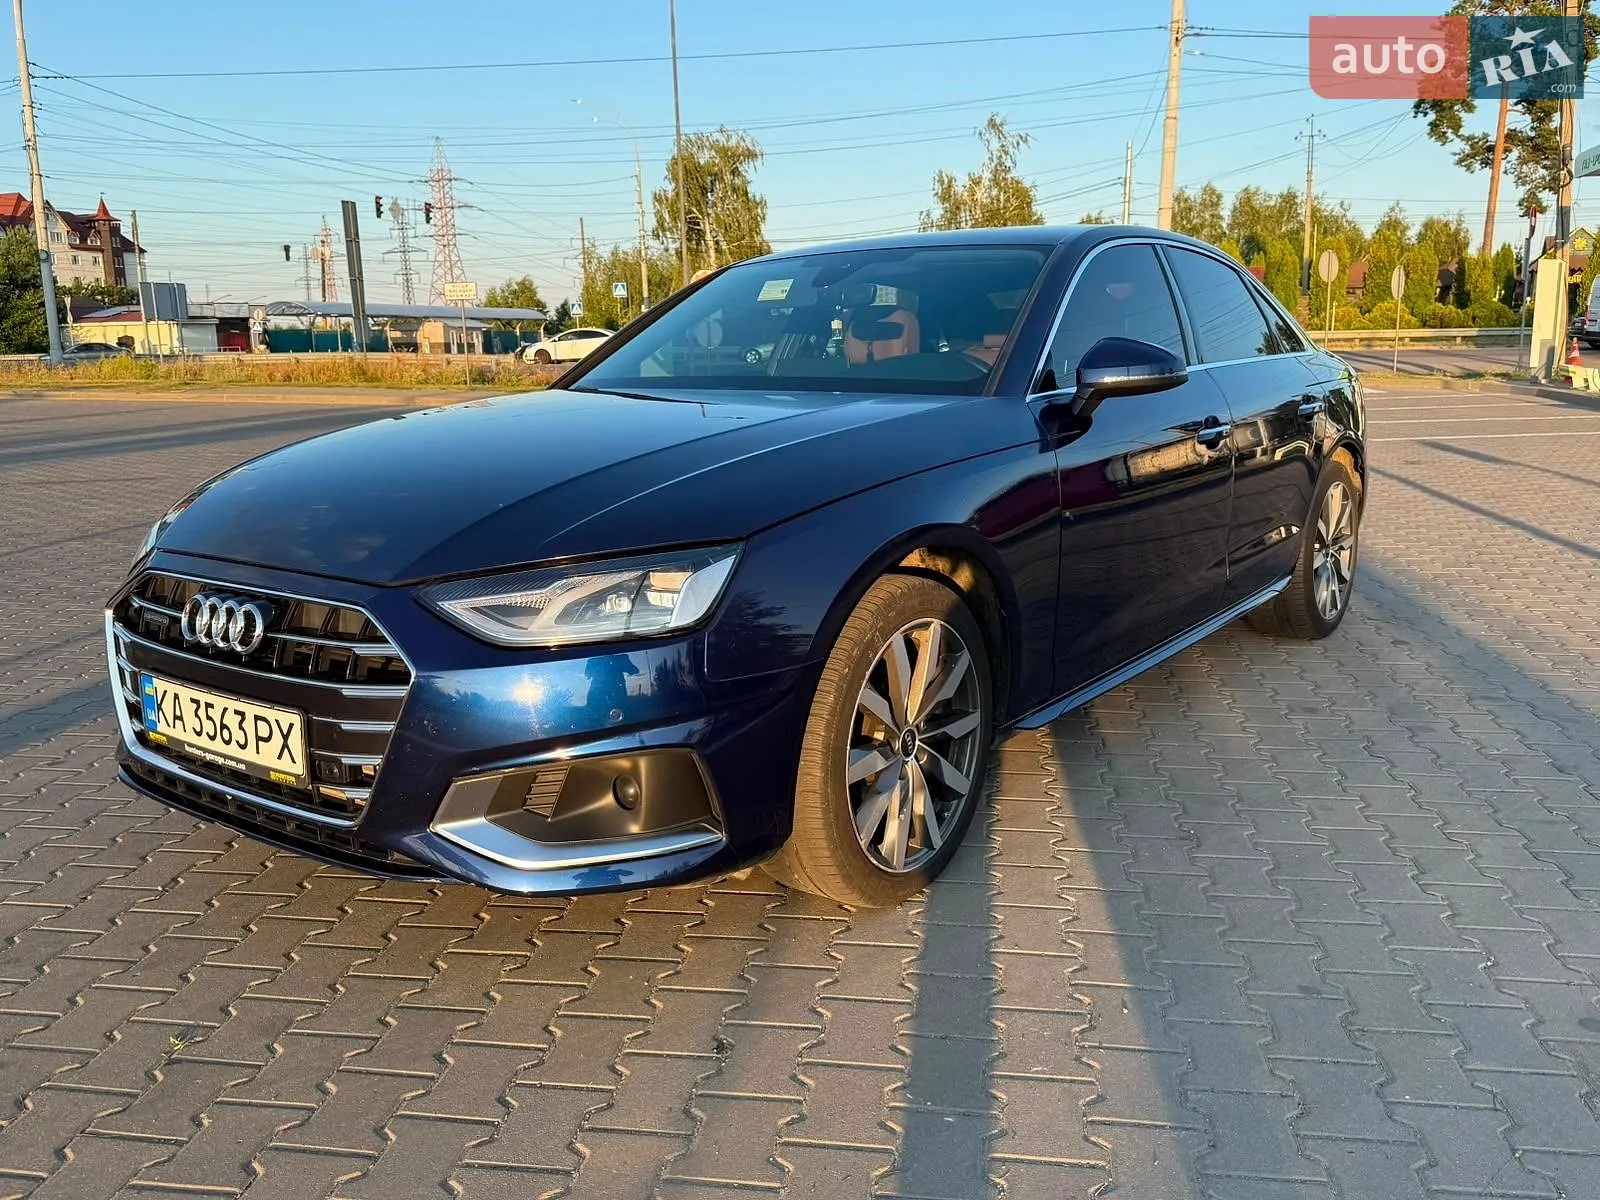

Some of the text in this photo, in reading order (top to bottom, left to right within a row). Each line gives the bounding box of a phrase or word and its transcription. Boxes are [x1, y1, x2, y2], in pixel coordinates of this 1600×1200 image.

[153, 686, 297, 764] KA 3563 PX
